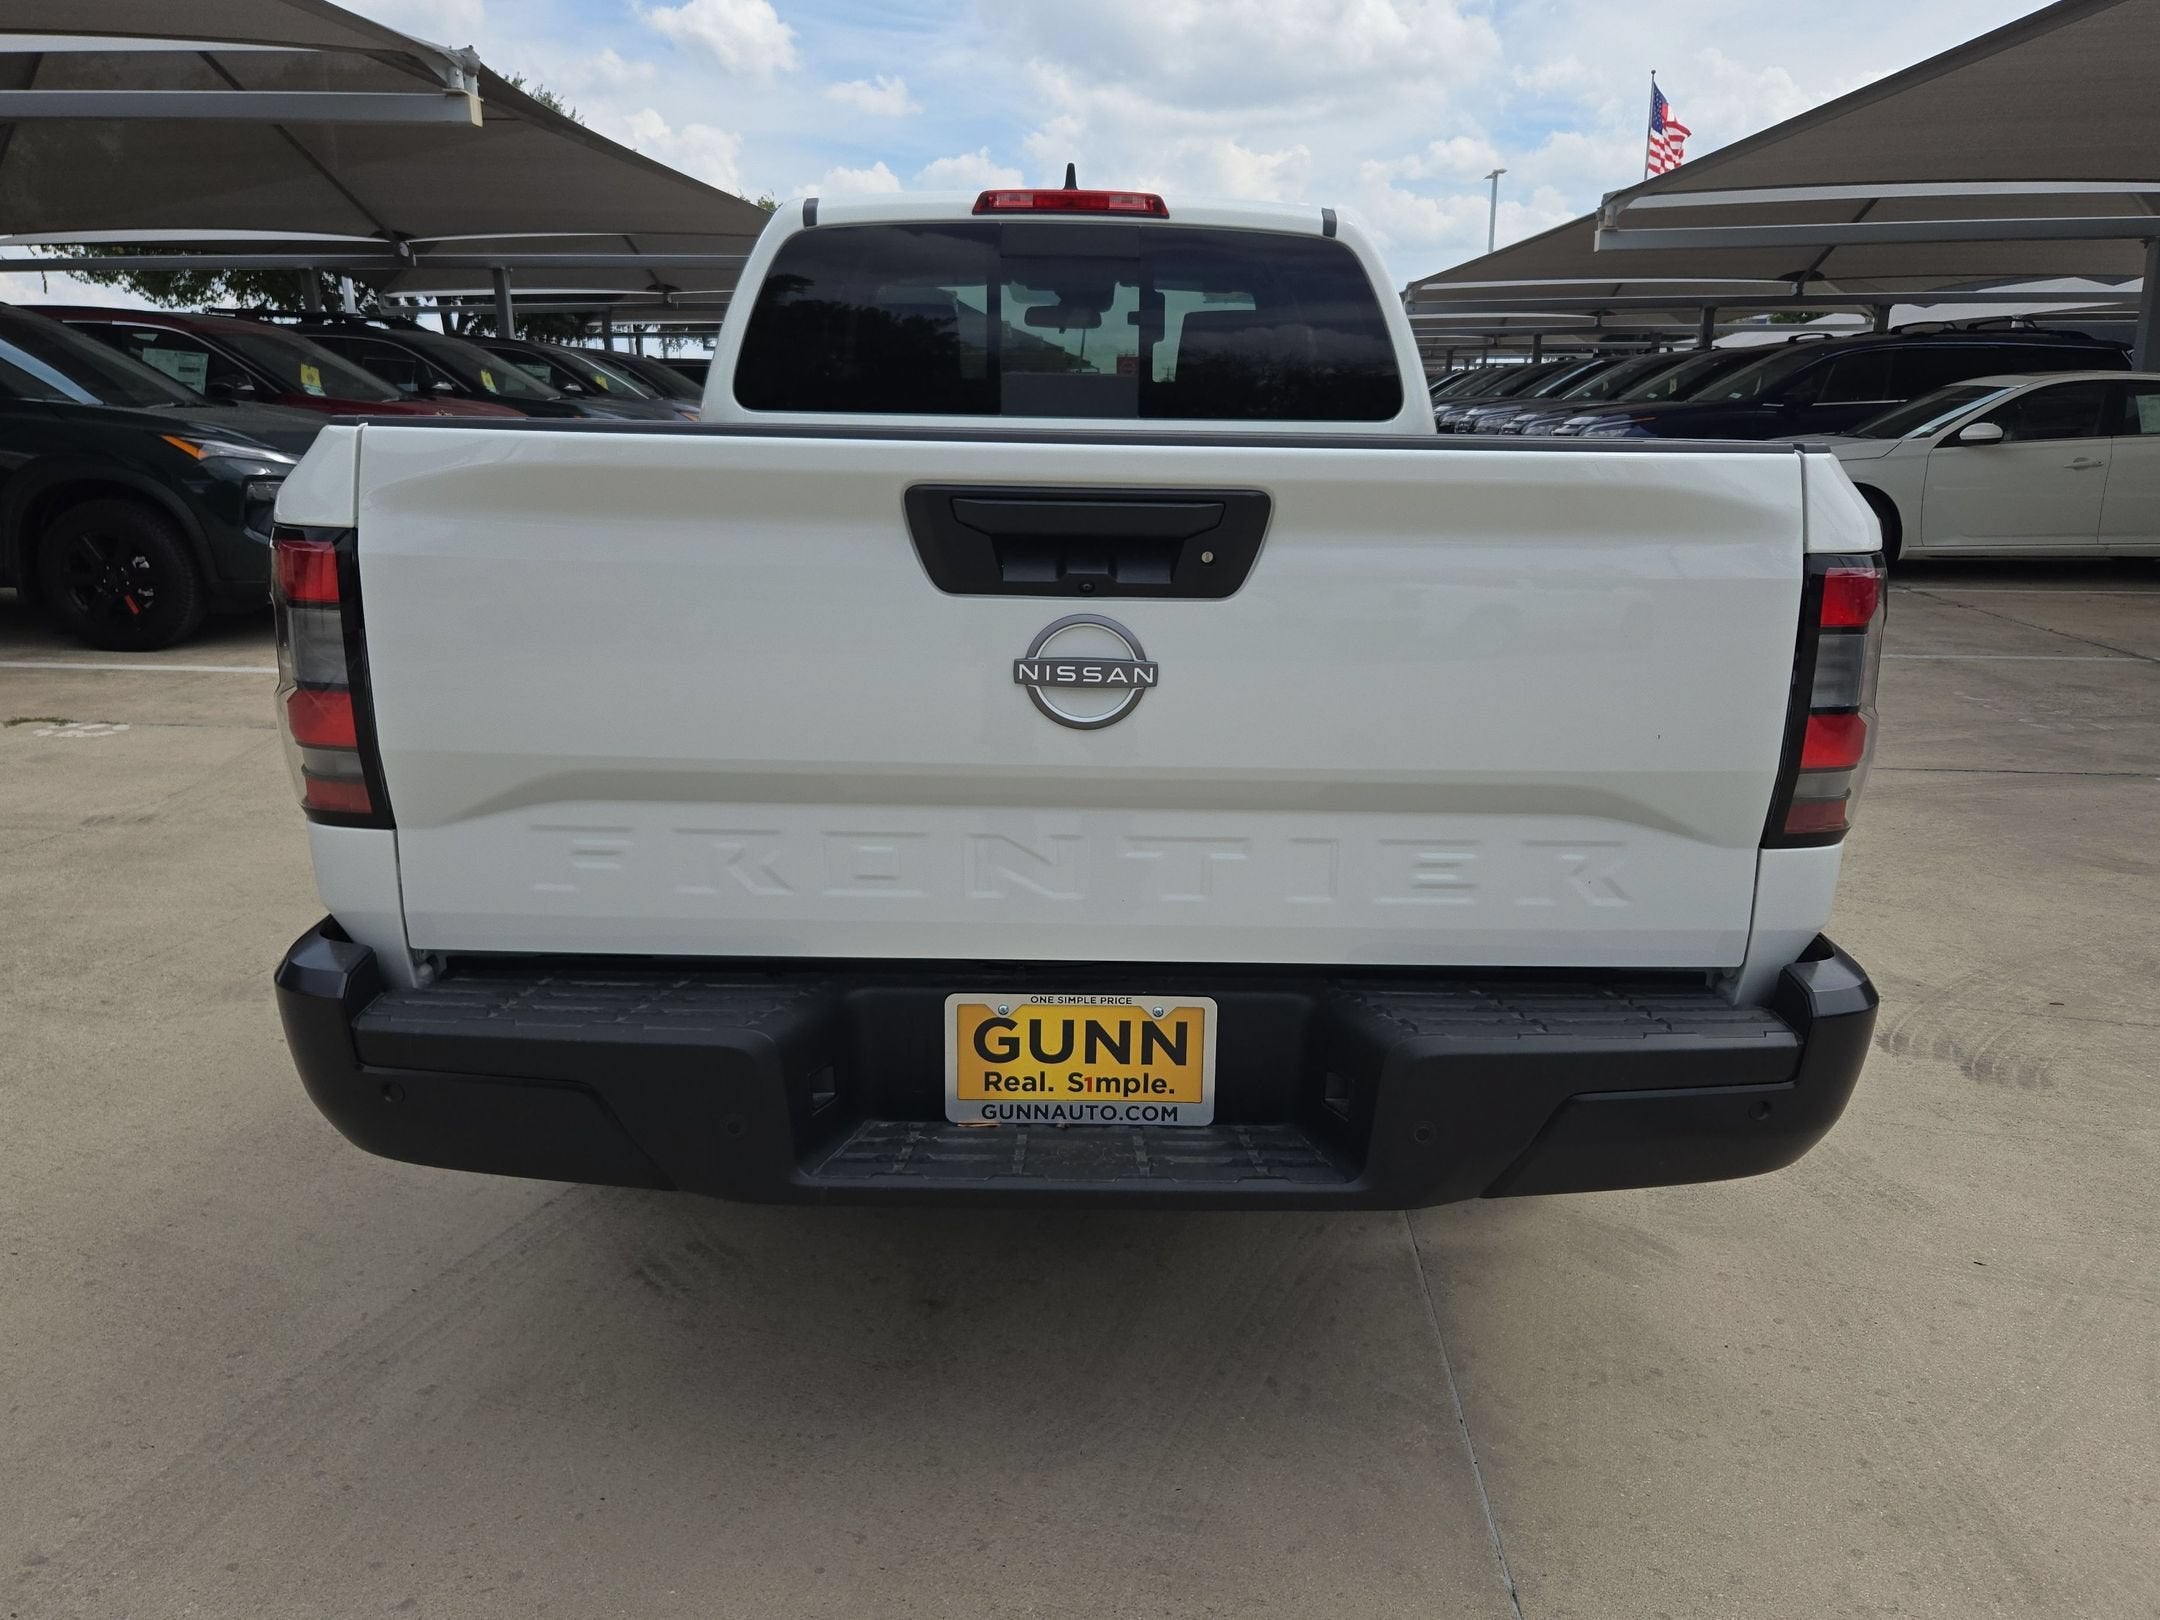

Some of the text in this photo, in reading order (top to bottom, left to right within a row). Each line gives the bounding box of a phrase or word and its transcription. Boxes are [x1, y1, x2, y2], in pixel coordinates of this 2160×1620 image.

[1018, 663, 1154, 684] NISSAN
[528, 824, 1633, 908] FRONTIER
[1030, 995, 1133, 1005] ONE SIMPLE PRICE
[973, 1017, 1188, 1066] GUNN
[984, 1071, 1054, 1092] Real.
[981, 1104, 1178, 1122] GUNNAUTO.COM
